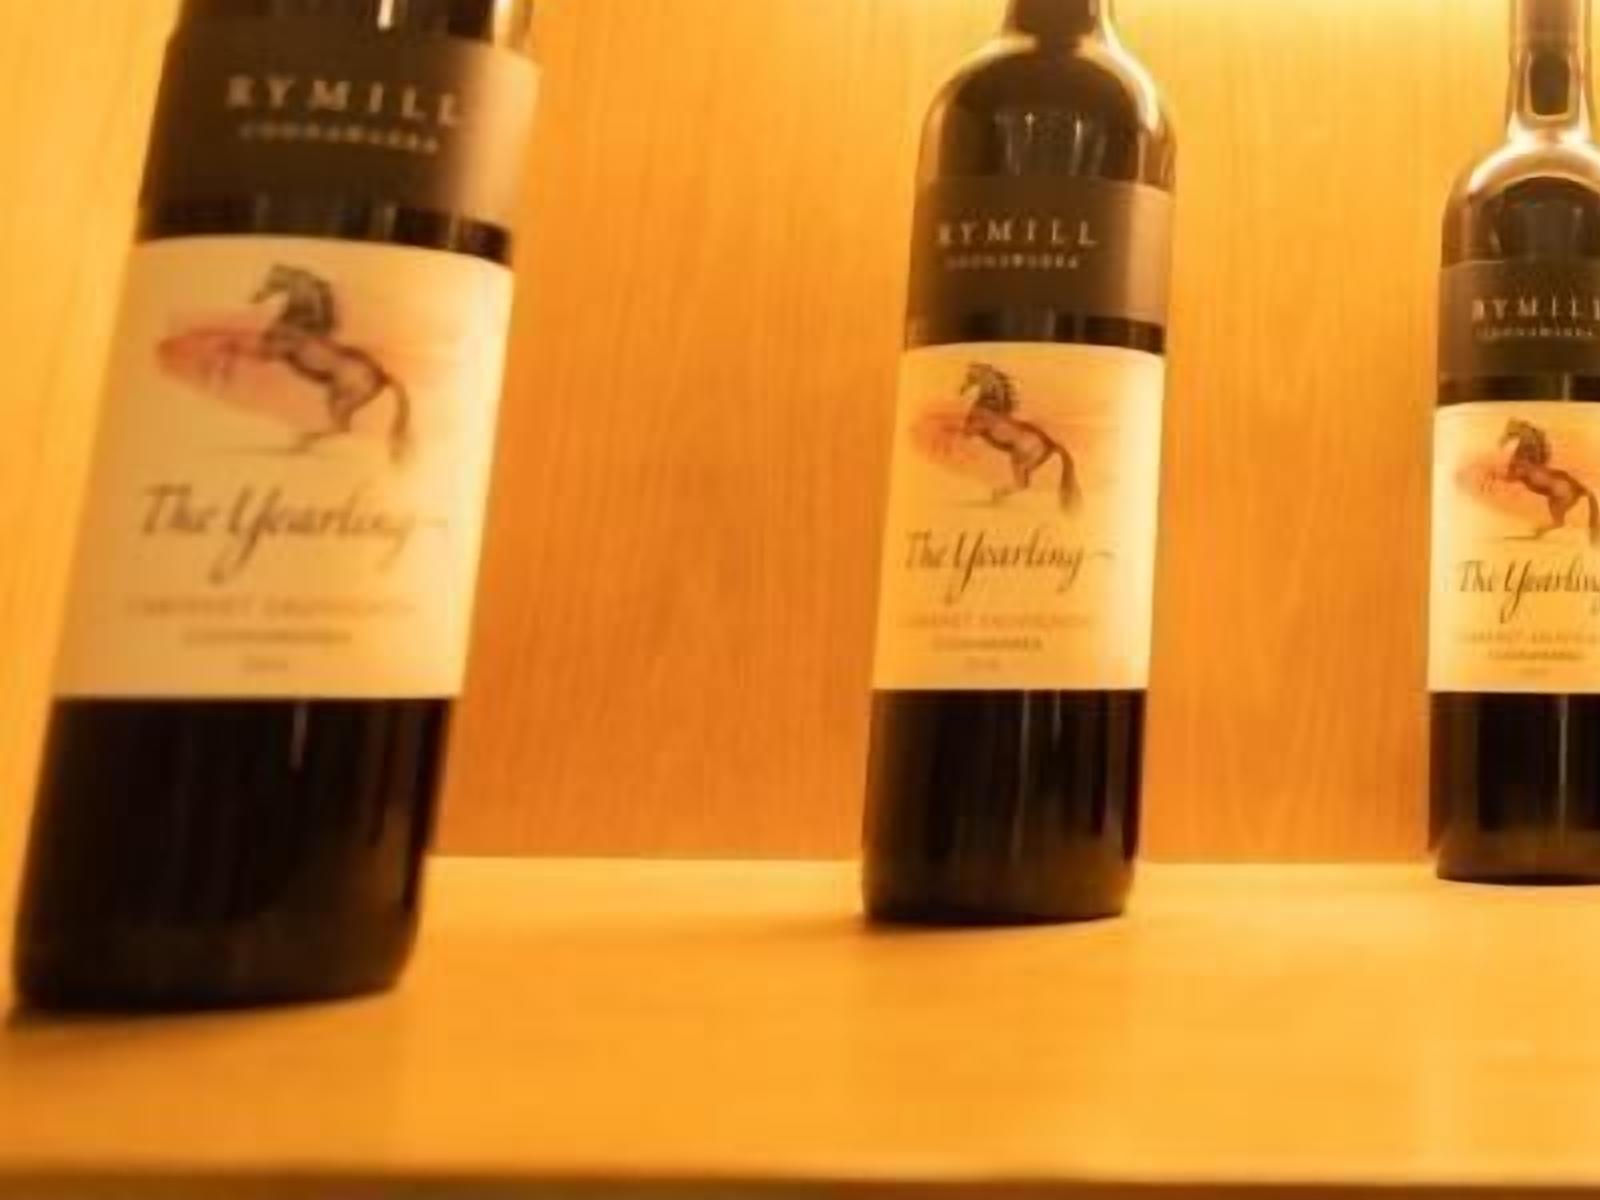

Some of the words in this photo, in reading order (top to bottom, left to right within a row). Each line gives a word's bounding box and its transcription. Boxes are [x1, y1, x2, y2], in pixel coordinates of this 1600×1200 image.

[226, 74, 459, 128] RYMILL
[140, 482, 219, 537] The
[205, 476, 448, 586] Yearling
[904, 530, 948, 572] The
[944, 524, 1115, 608] Yearling
